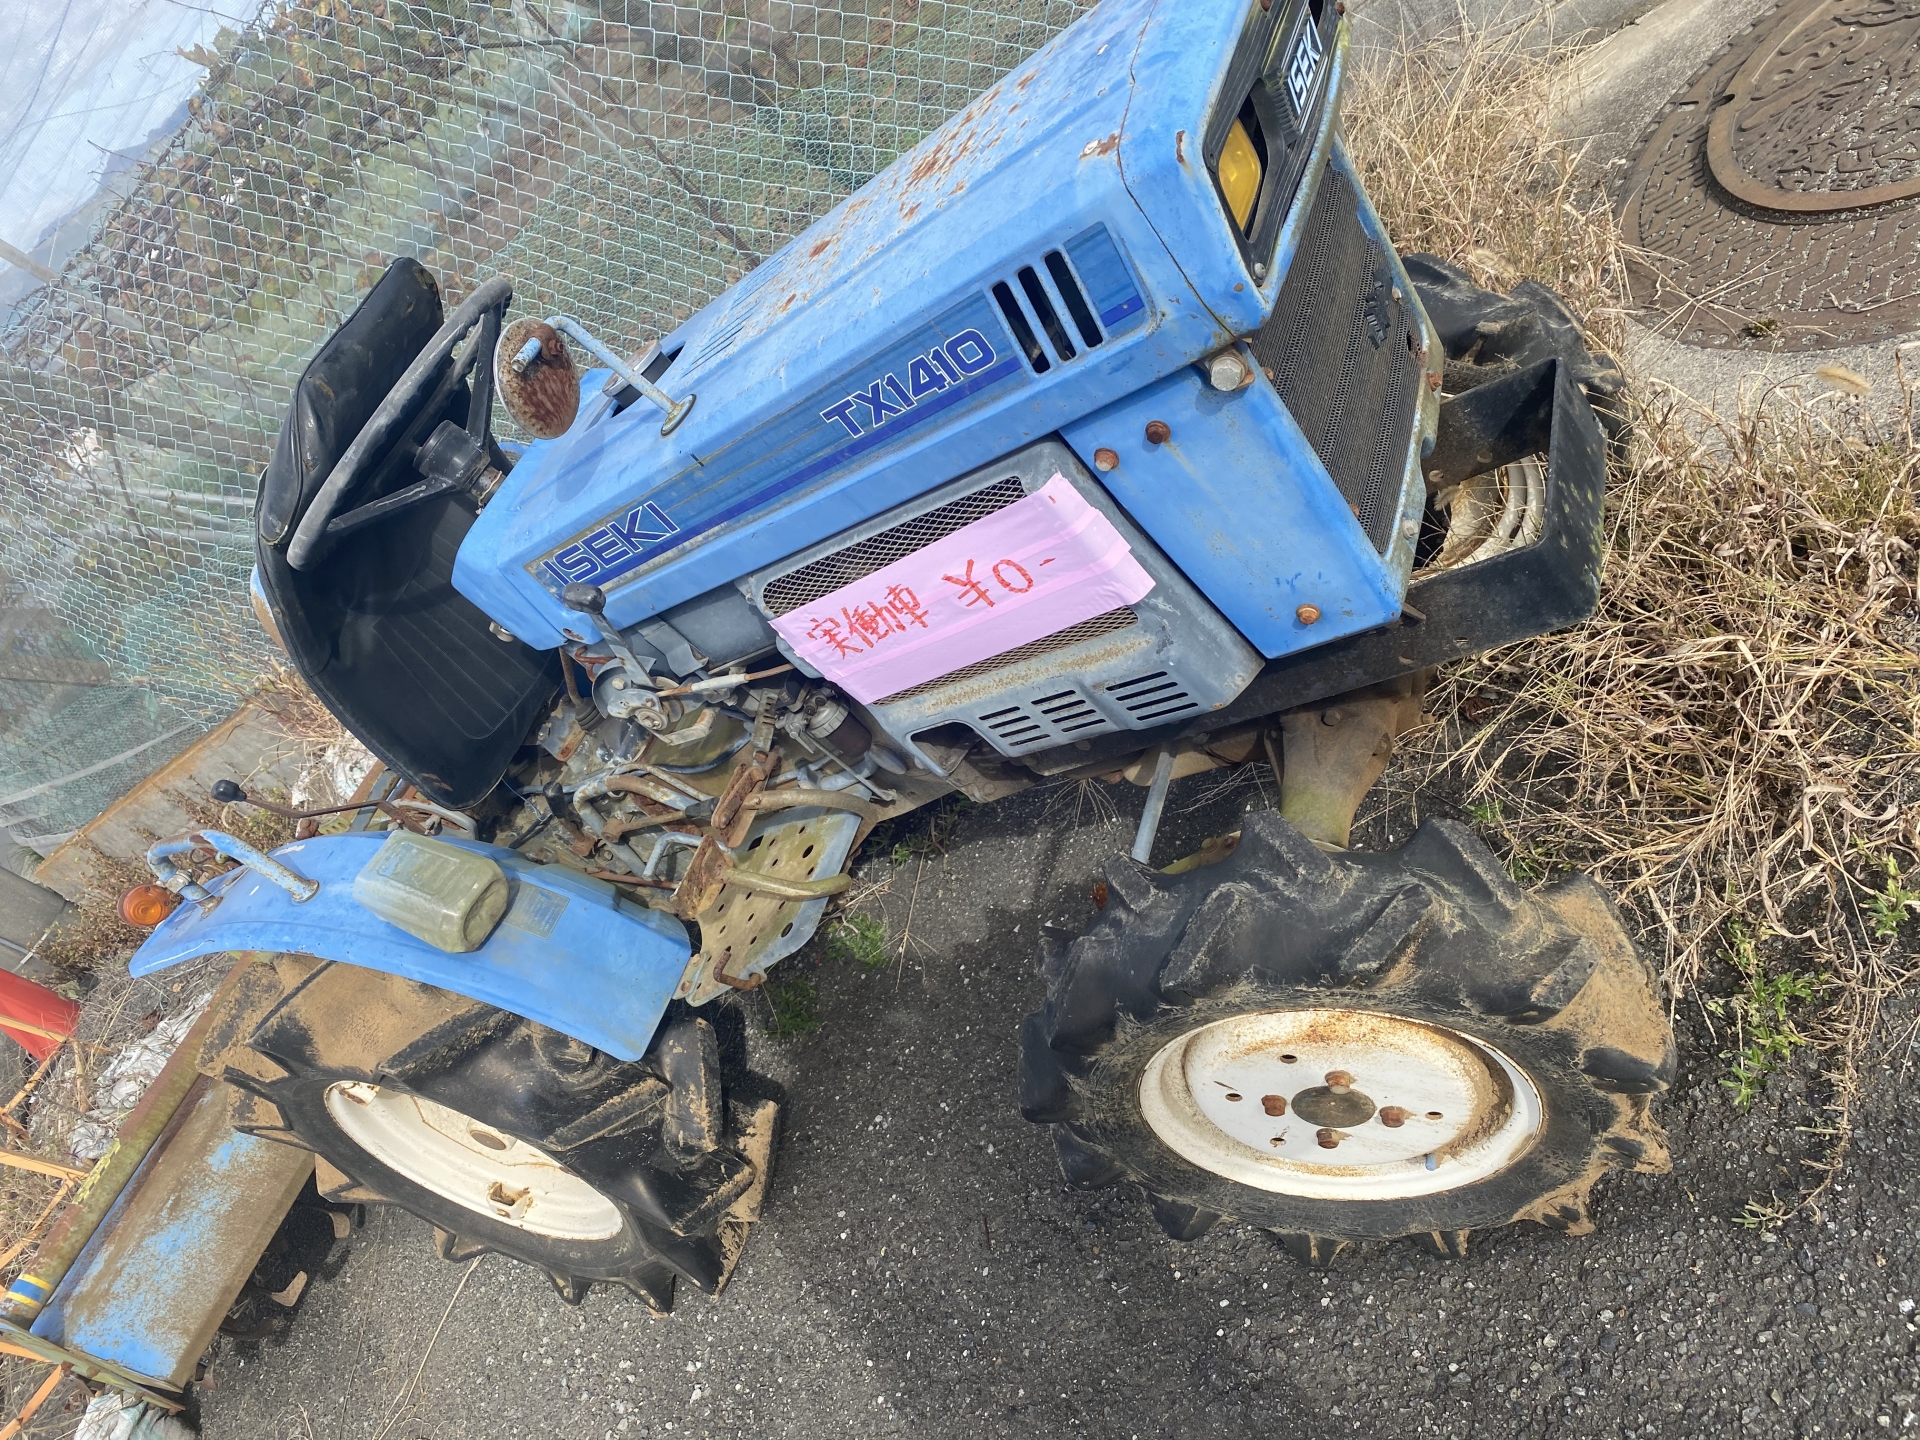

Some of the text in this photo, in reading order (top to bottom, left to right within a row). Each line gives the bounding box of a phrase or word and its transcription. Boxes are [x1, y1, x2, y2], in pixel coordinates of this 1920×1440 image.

[1287, 14, 1323, 116] ISEKI
[819, 328, 997, 438] TX1410
[540, 500, 680, 586] ISEKI
[806, 582, 929, 660] 実働車
